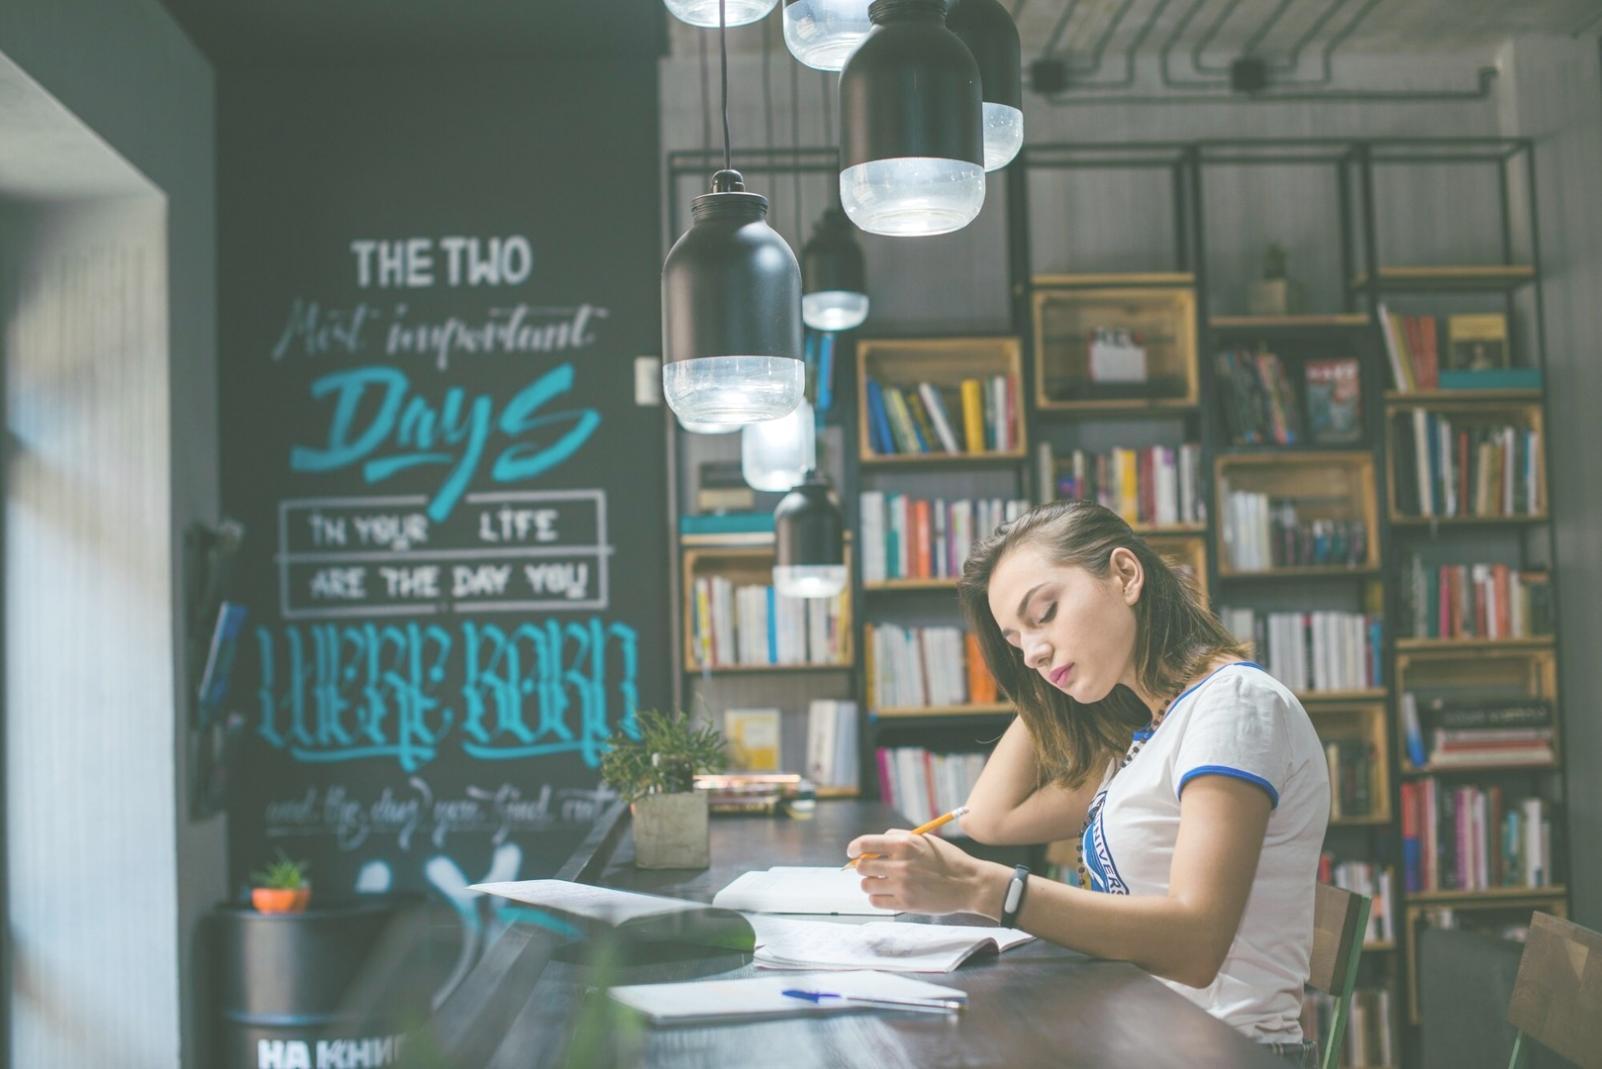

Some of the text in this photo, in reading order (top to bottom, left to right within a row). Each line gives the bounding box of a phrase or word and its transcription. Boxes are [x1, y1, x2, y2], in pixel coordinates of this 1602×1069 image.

[351, 235, 532, 287] THE TWO
[386, 302, 609, 371] important
[353, 513, 428, 551] YOUR
[479, 505, 559, 542] LIFE
[310, 563, 588, 599] ARE THE DAY YOU
